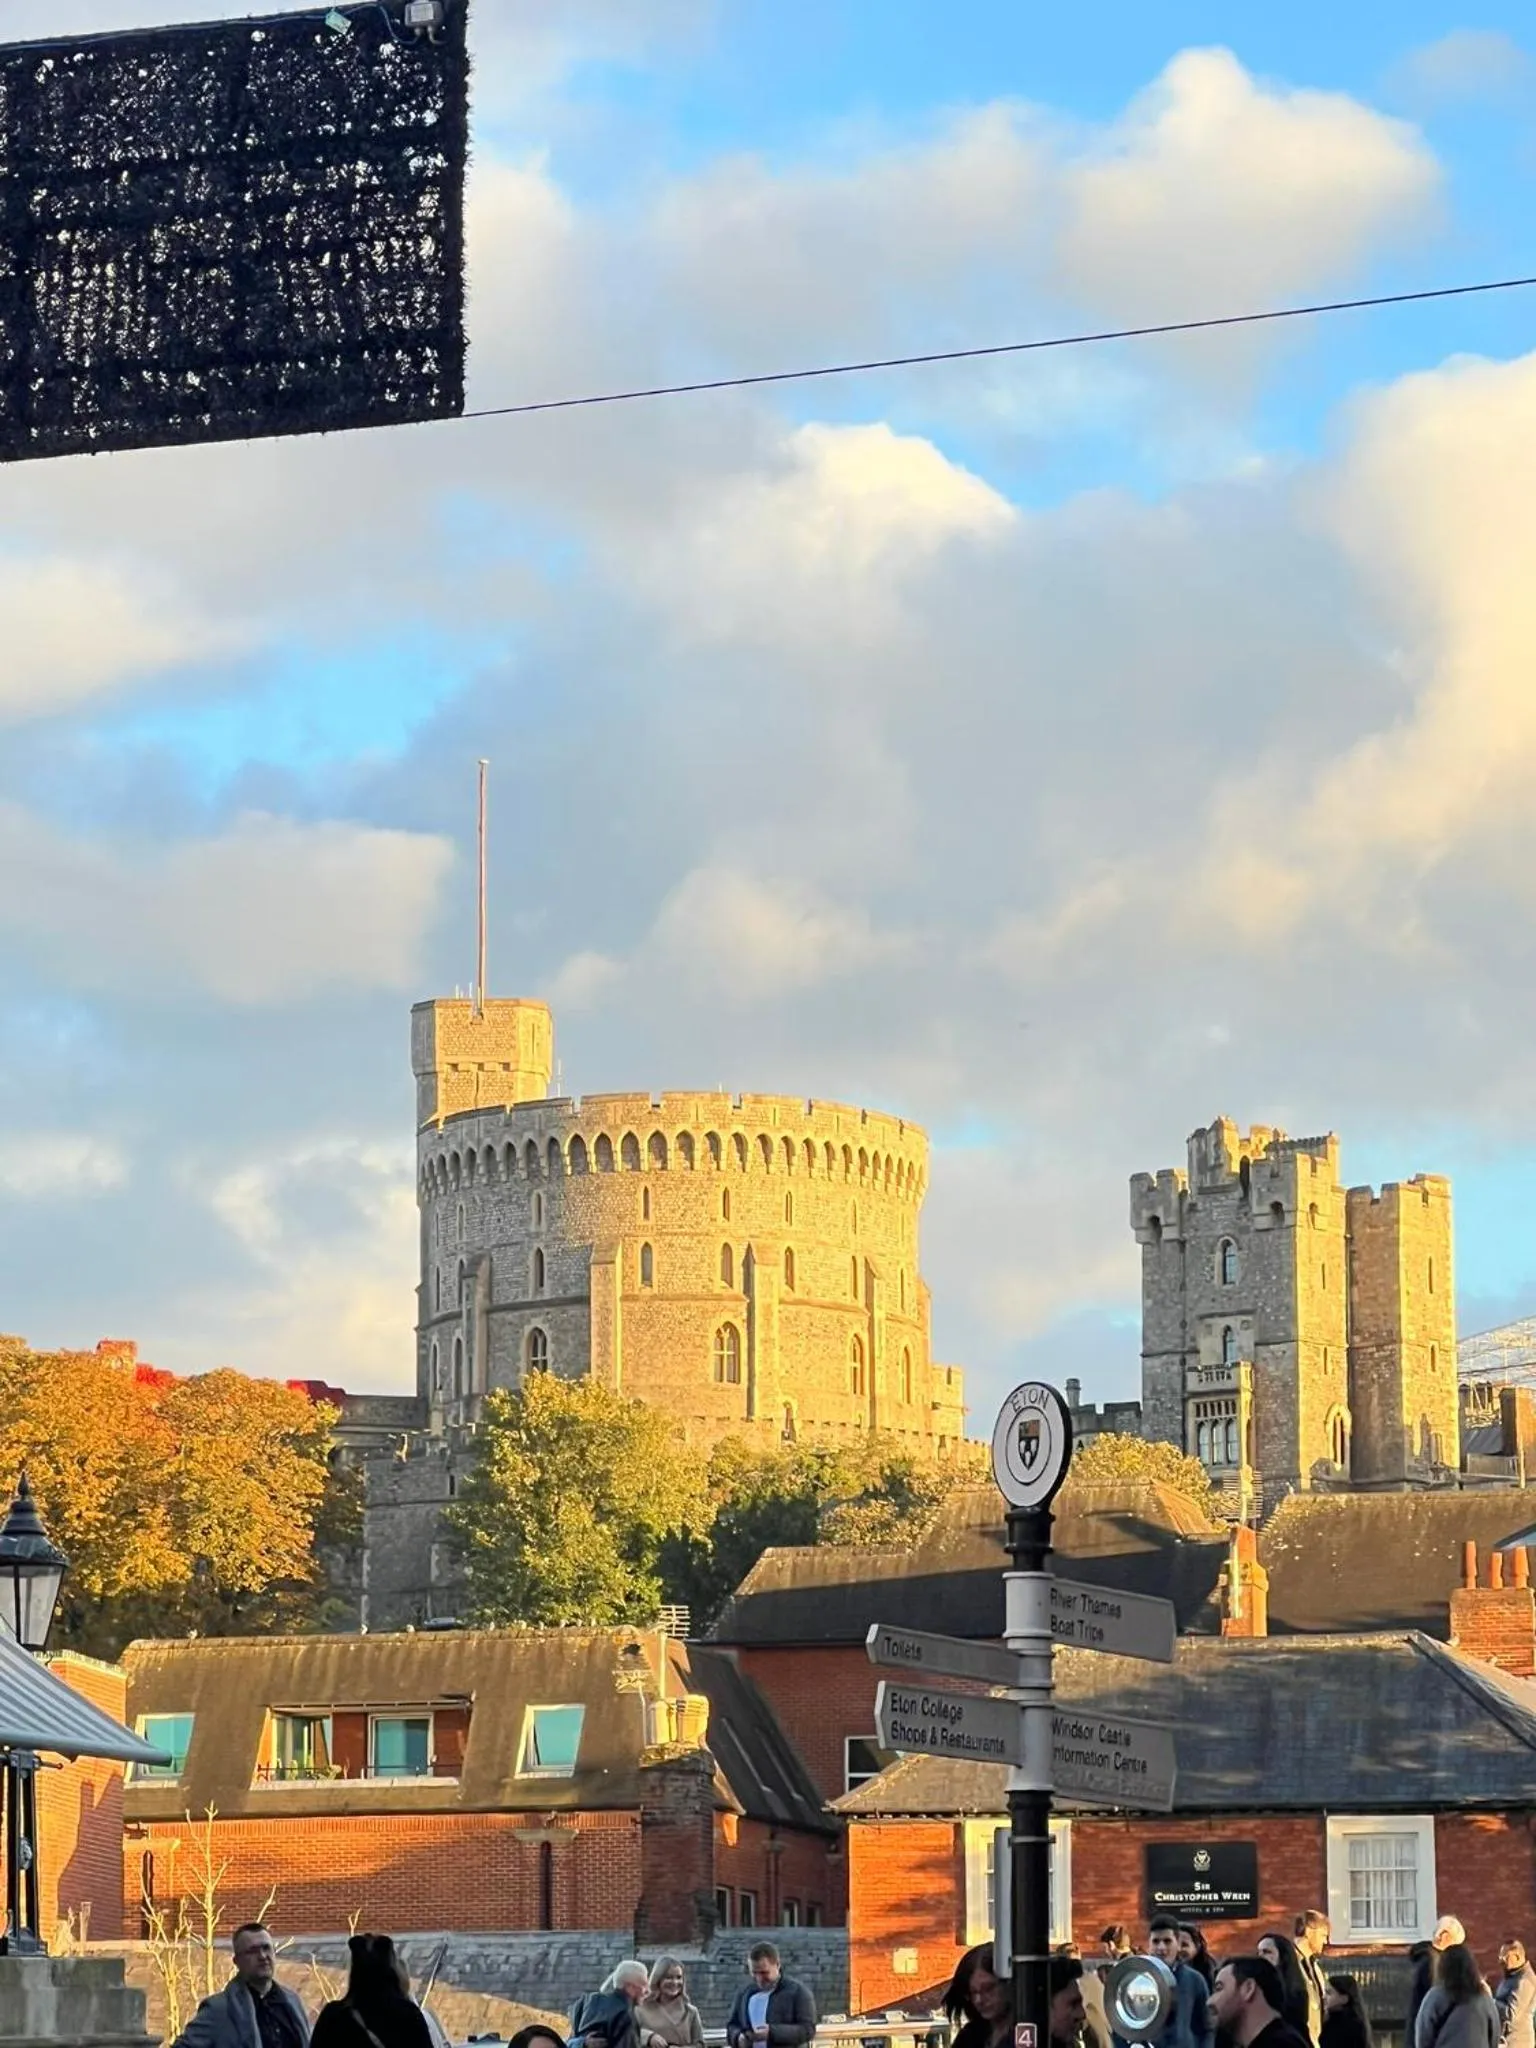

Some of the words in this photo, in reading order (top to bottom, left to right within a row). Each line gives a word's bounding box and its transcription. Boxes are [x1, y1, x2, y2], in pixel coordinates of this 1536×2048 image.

[1011, 1388, 1049, 1413] ETON
[1050, 1588, 1077, 1609] River
[1081, 1593, 1121, 1619] Thames
[1050, 1614, 1075, 1636] Boat
[1077, 1619, 1104, 1641] Trips
[884, 1636, 922, 1661] Toilets
[890, 1692, 917, 1715] Eton
[921, 1697, 963, 1724] College
[891, 1720, 927, 1744] Shops
[930, 1726, 937, 1746] &
[941, 1728, 1006, 1754] Restaurants
[1052, 1717, 1094, 1740] Windsor
[1099, 1723, 1131, 1747] Castle
[1053, 1746, 1110, 1769] nformation
[1114, 1752, 1147, 1774] Centre
[1018, 2029, 1032, 2046] 4
